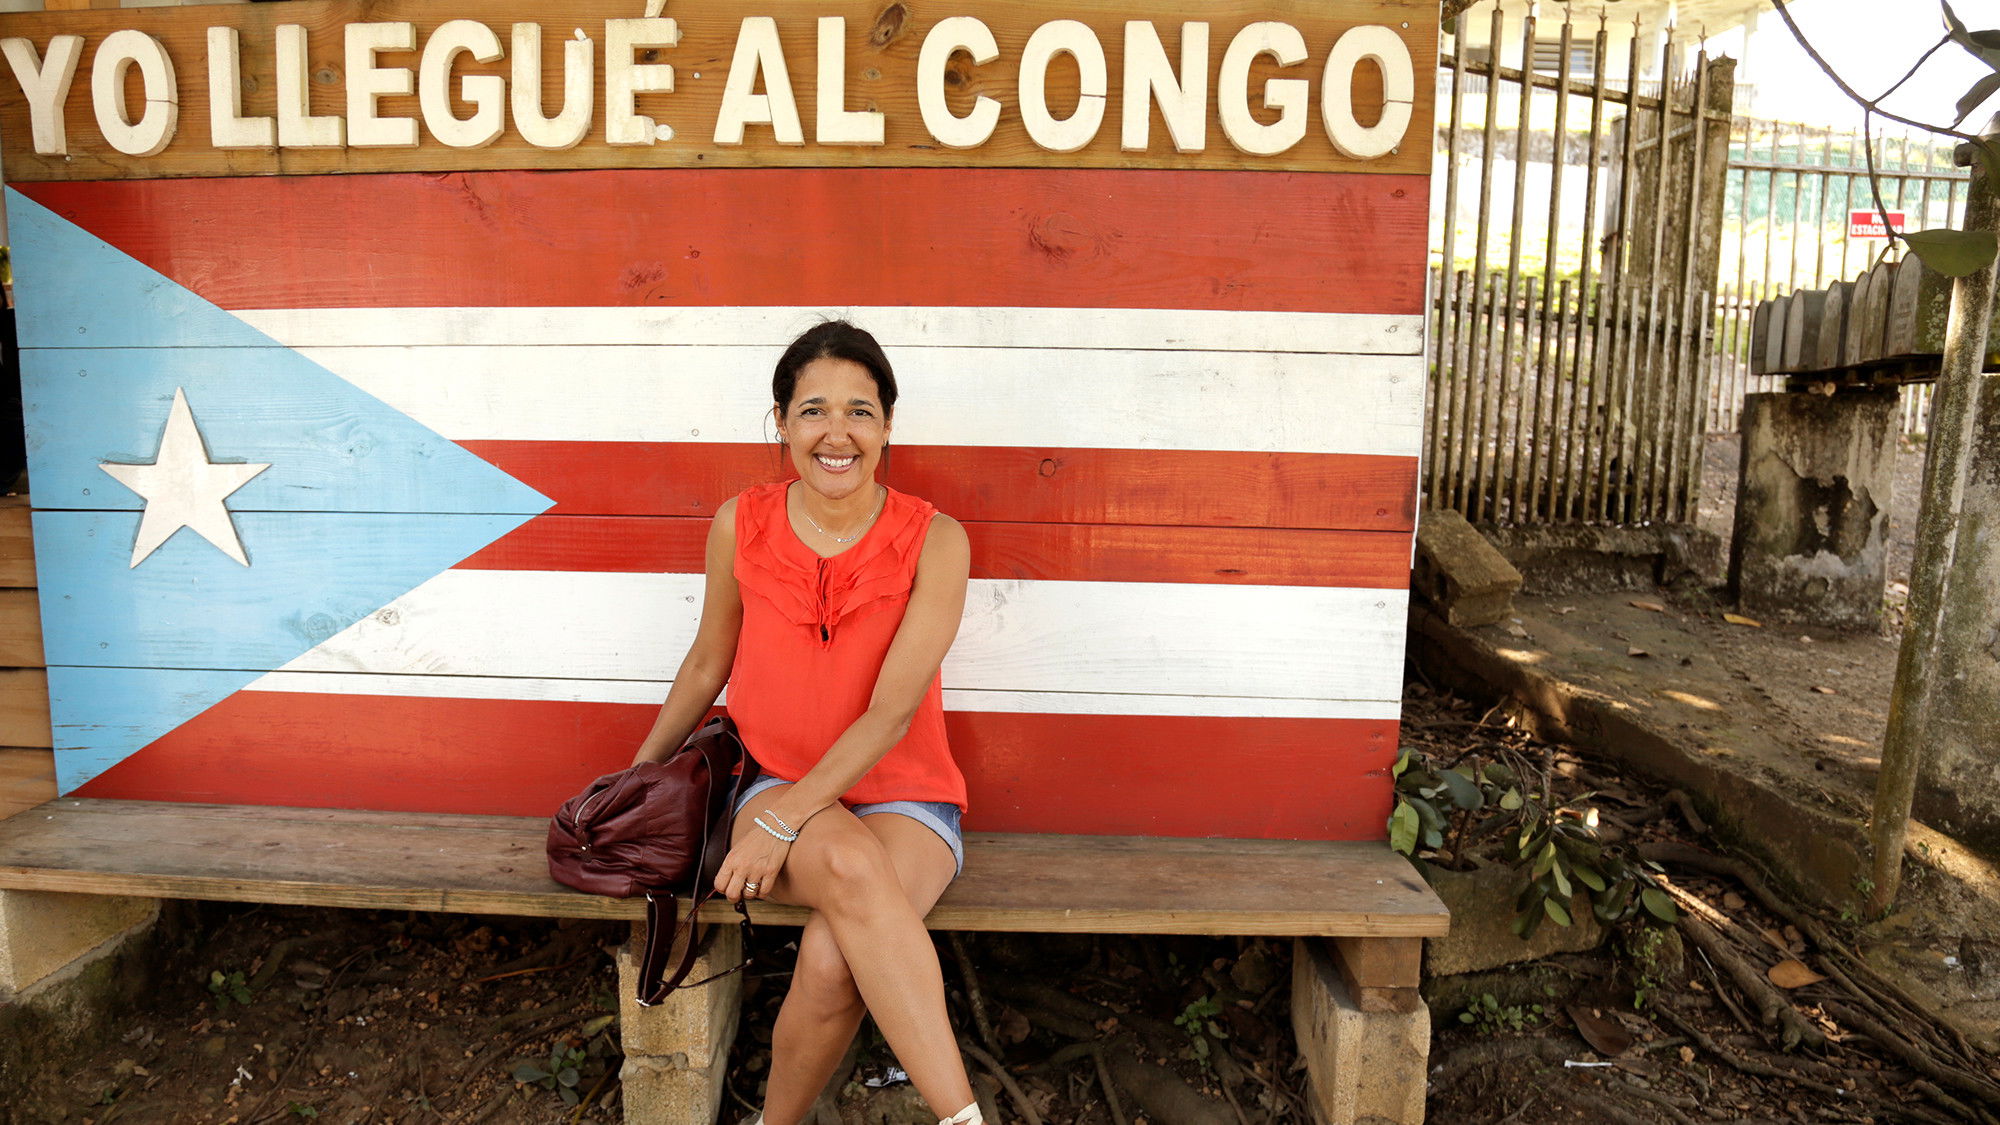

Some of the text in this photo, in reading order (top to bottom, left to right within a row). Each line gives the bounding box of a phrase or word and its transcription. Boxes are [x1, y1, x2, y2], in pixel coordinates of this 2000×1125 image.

[0, 0, 1415, 160] YO LLEGUÉ AL CONGO
